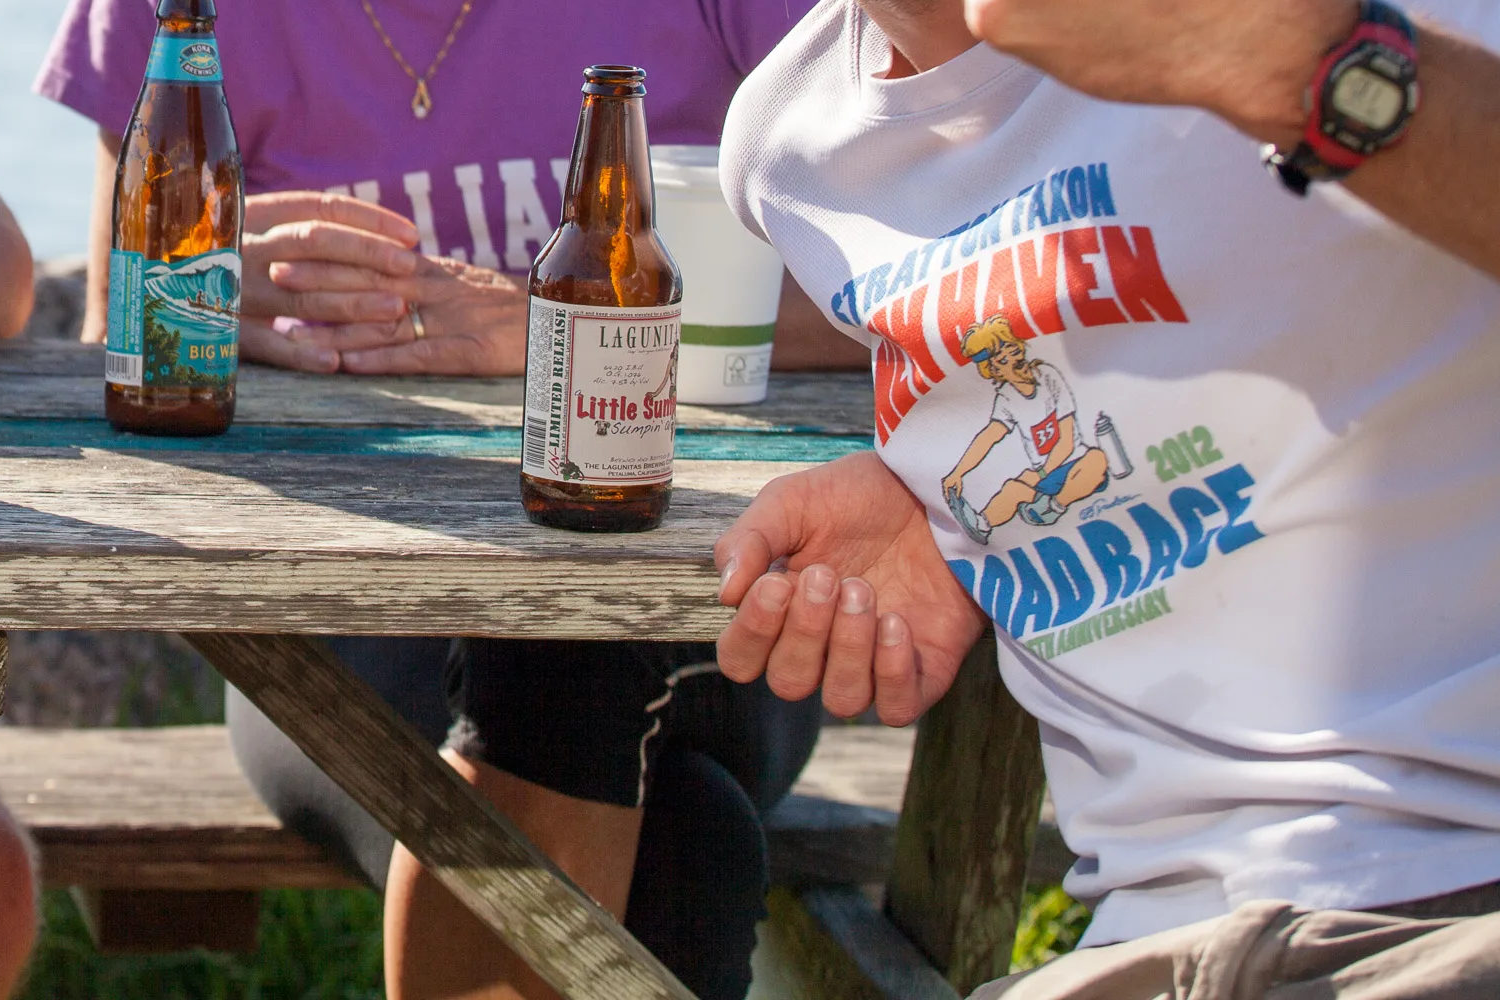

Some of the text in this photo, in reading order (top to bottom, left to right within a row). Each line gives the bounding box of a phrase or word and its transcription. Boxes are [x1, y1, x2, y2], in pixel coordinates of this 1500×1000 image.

[184, 63, 212, 75] BREWING
[192, 44, 211, 53] KONA
[831, 197, 1010, 328] STRATTON
[937, 225, 1189, 365] HAVEN
[189, 344, 216, 360] BIG
[552, 308, 566, 379] RELEASE
[576, 393, 638, 421] Little
[1035, 421, 1056, 448] 35
[1145, 425, 1224, 484] 2012
[584, 462, 600, 470] THE
[602, 463, 642, 471] LAGUNITAS
[643, 460, 666, 470] BREWING
[1076, 463, 1269, 608] RACE
[1056, 585, 1173, 656] ANNIVERSARY
